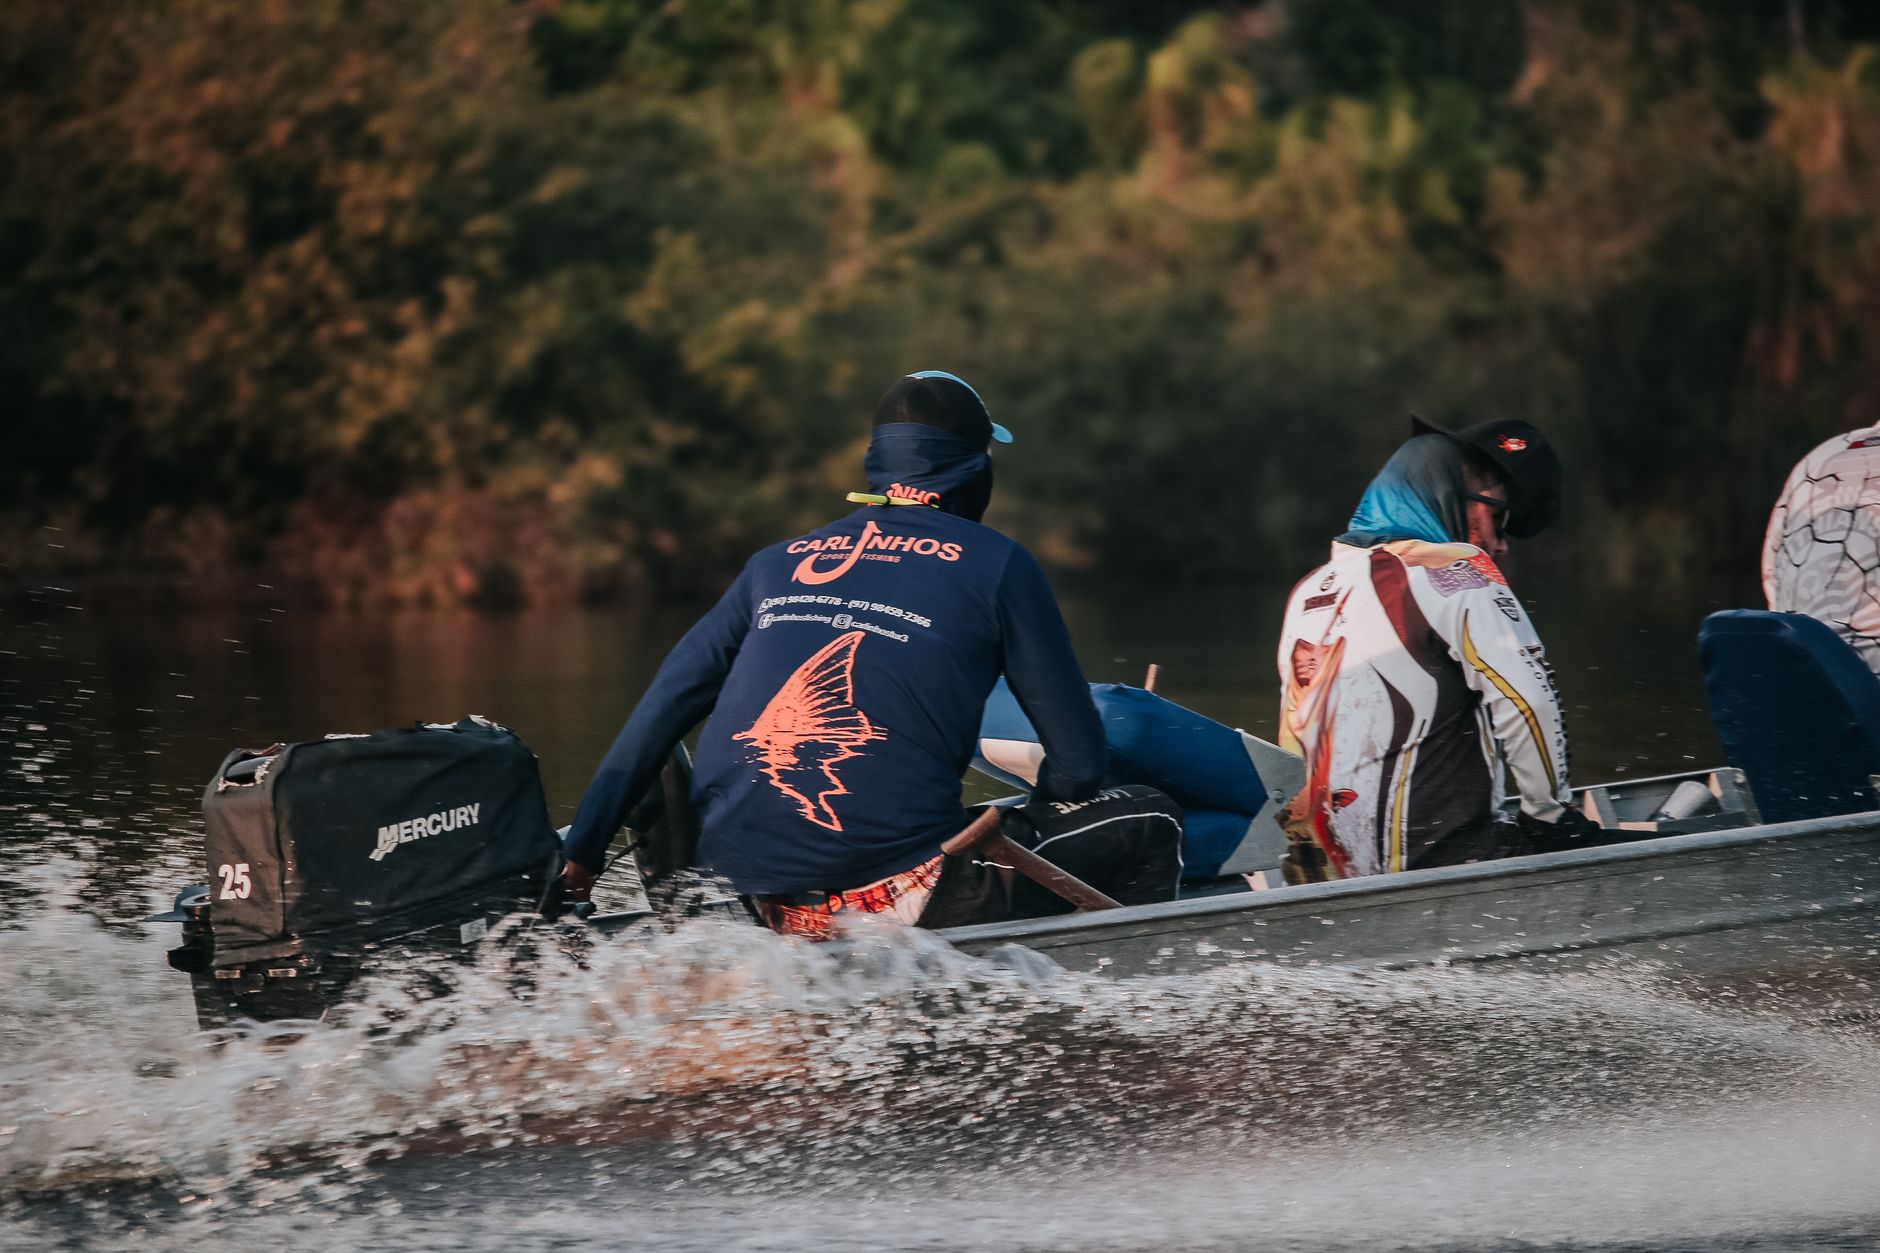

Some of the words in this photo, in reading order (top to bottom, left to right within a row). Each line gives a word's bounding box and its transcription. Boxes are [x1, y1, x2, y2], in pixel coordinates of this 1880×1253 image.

[860, 553, 902, 563] FISHING
[1049, 788, 1132, 814] LACTE
[369, 803, 480, 862] MERCURY
[218, 863, 252, 900] 25
